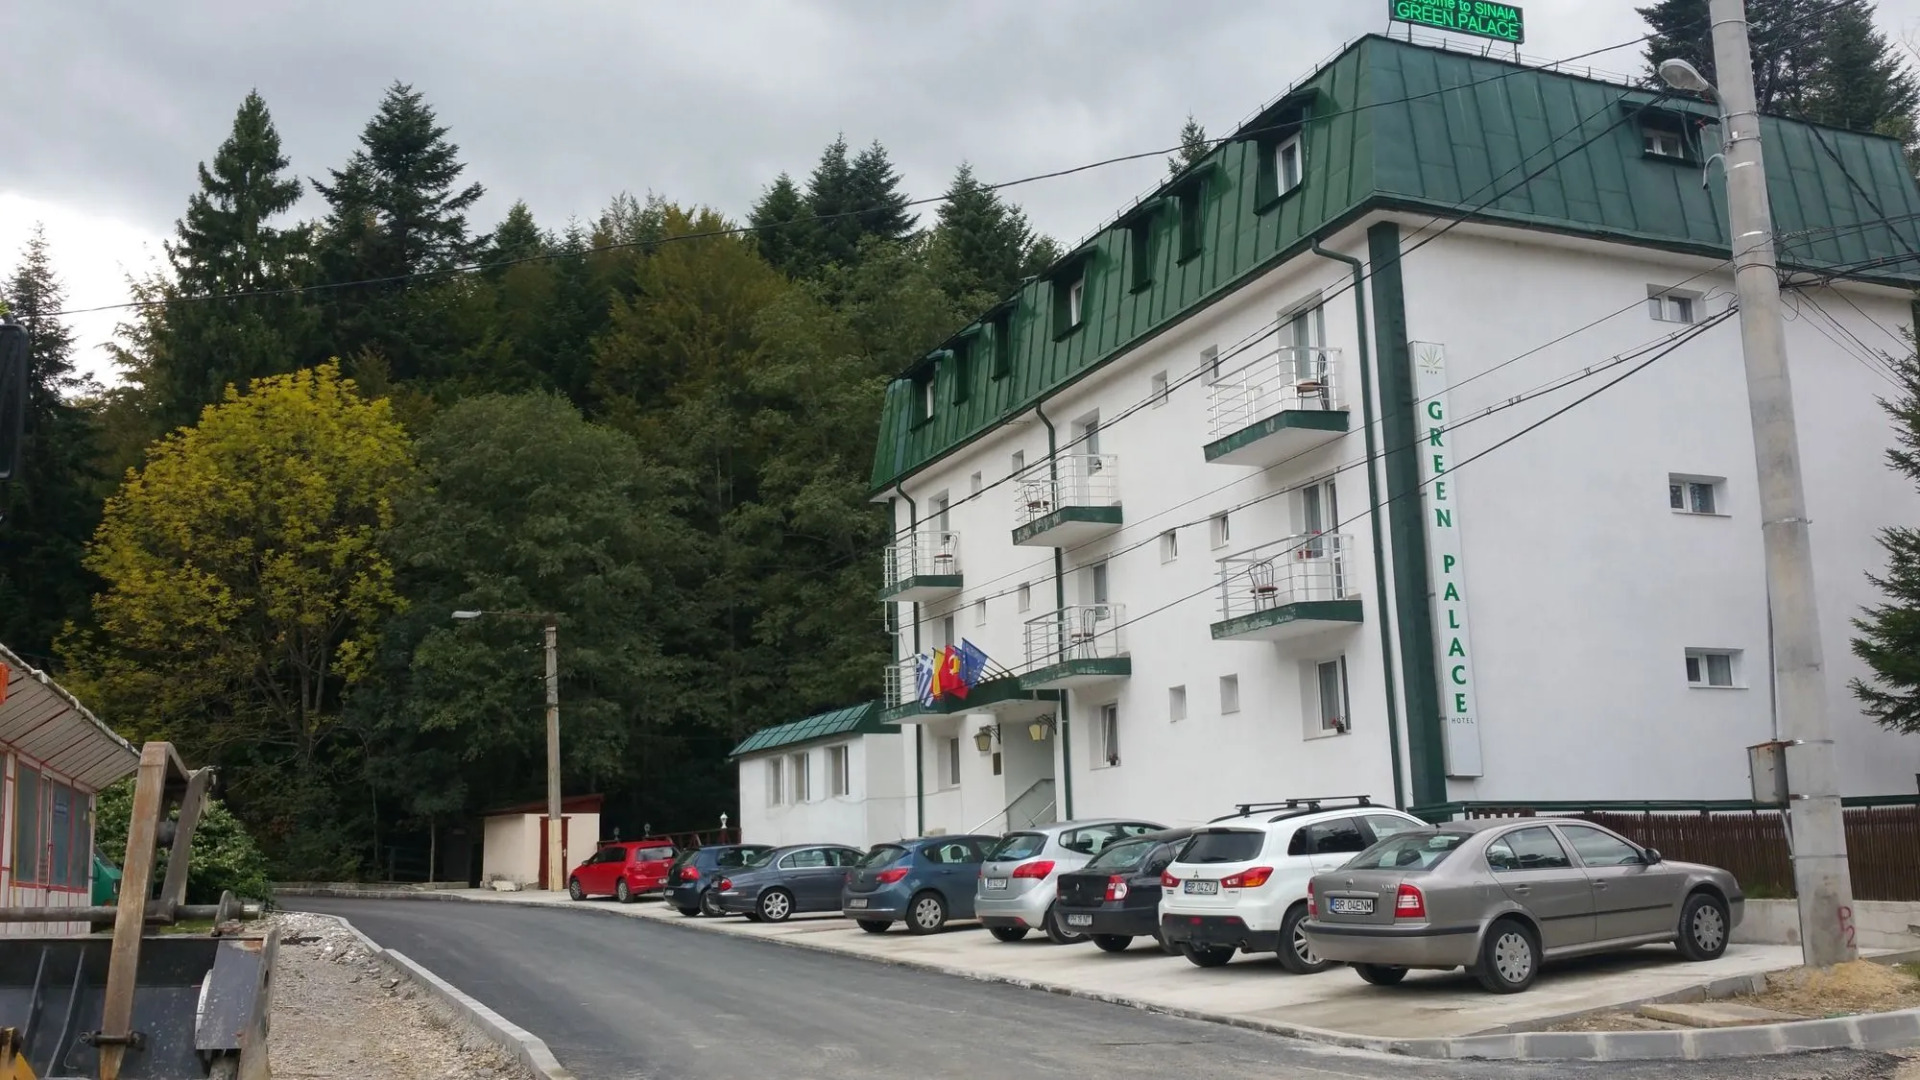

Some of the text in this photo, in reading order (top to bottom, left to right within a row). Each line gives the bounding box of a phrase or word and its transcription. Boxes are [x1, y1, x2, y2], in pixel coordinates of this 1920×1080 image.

[1397, 2, 1519, 38] GREEN PALACE
[1458, 0, 1471, 12] to
[1474, 1, 1518, 21] SINAIA
[1427, 400, 1468, 713] GREEN PALACE
[1335, 900, 1372, 911] BR 04ENM
